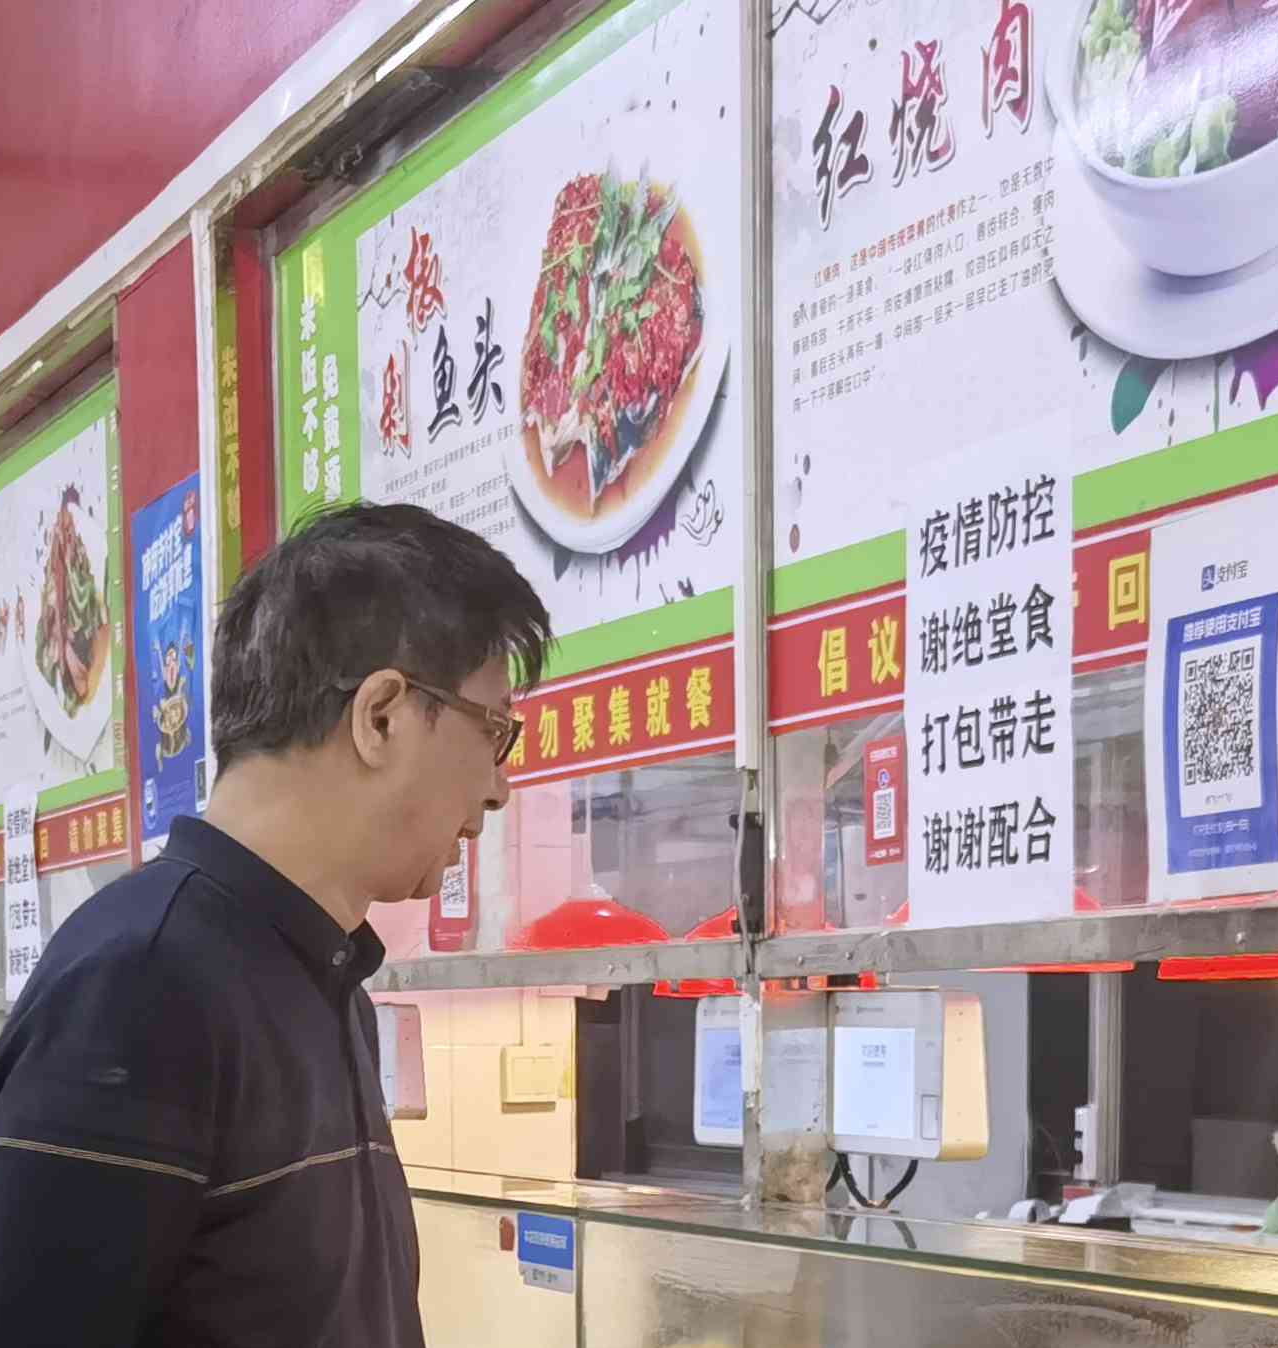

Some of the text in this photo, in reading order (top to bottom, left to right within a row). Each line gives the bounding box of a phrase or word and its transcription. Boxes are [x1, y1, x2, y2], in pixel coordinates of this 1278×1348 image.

[812, 0, 1034, 231] 红烧肉
[919, 473, 1057, 578] 疫情防控
[1107, 551, 1148, 632] 回
[1216, 560, 1249, 585] 支付宝
[817, 614, 901, 698] 倡议
[918, 582, 1056, 676] 谢绝堂食
[921, 689, 1057, 777] 打包带走
[923, 795, 1057, 876] 谢谢配合
